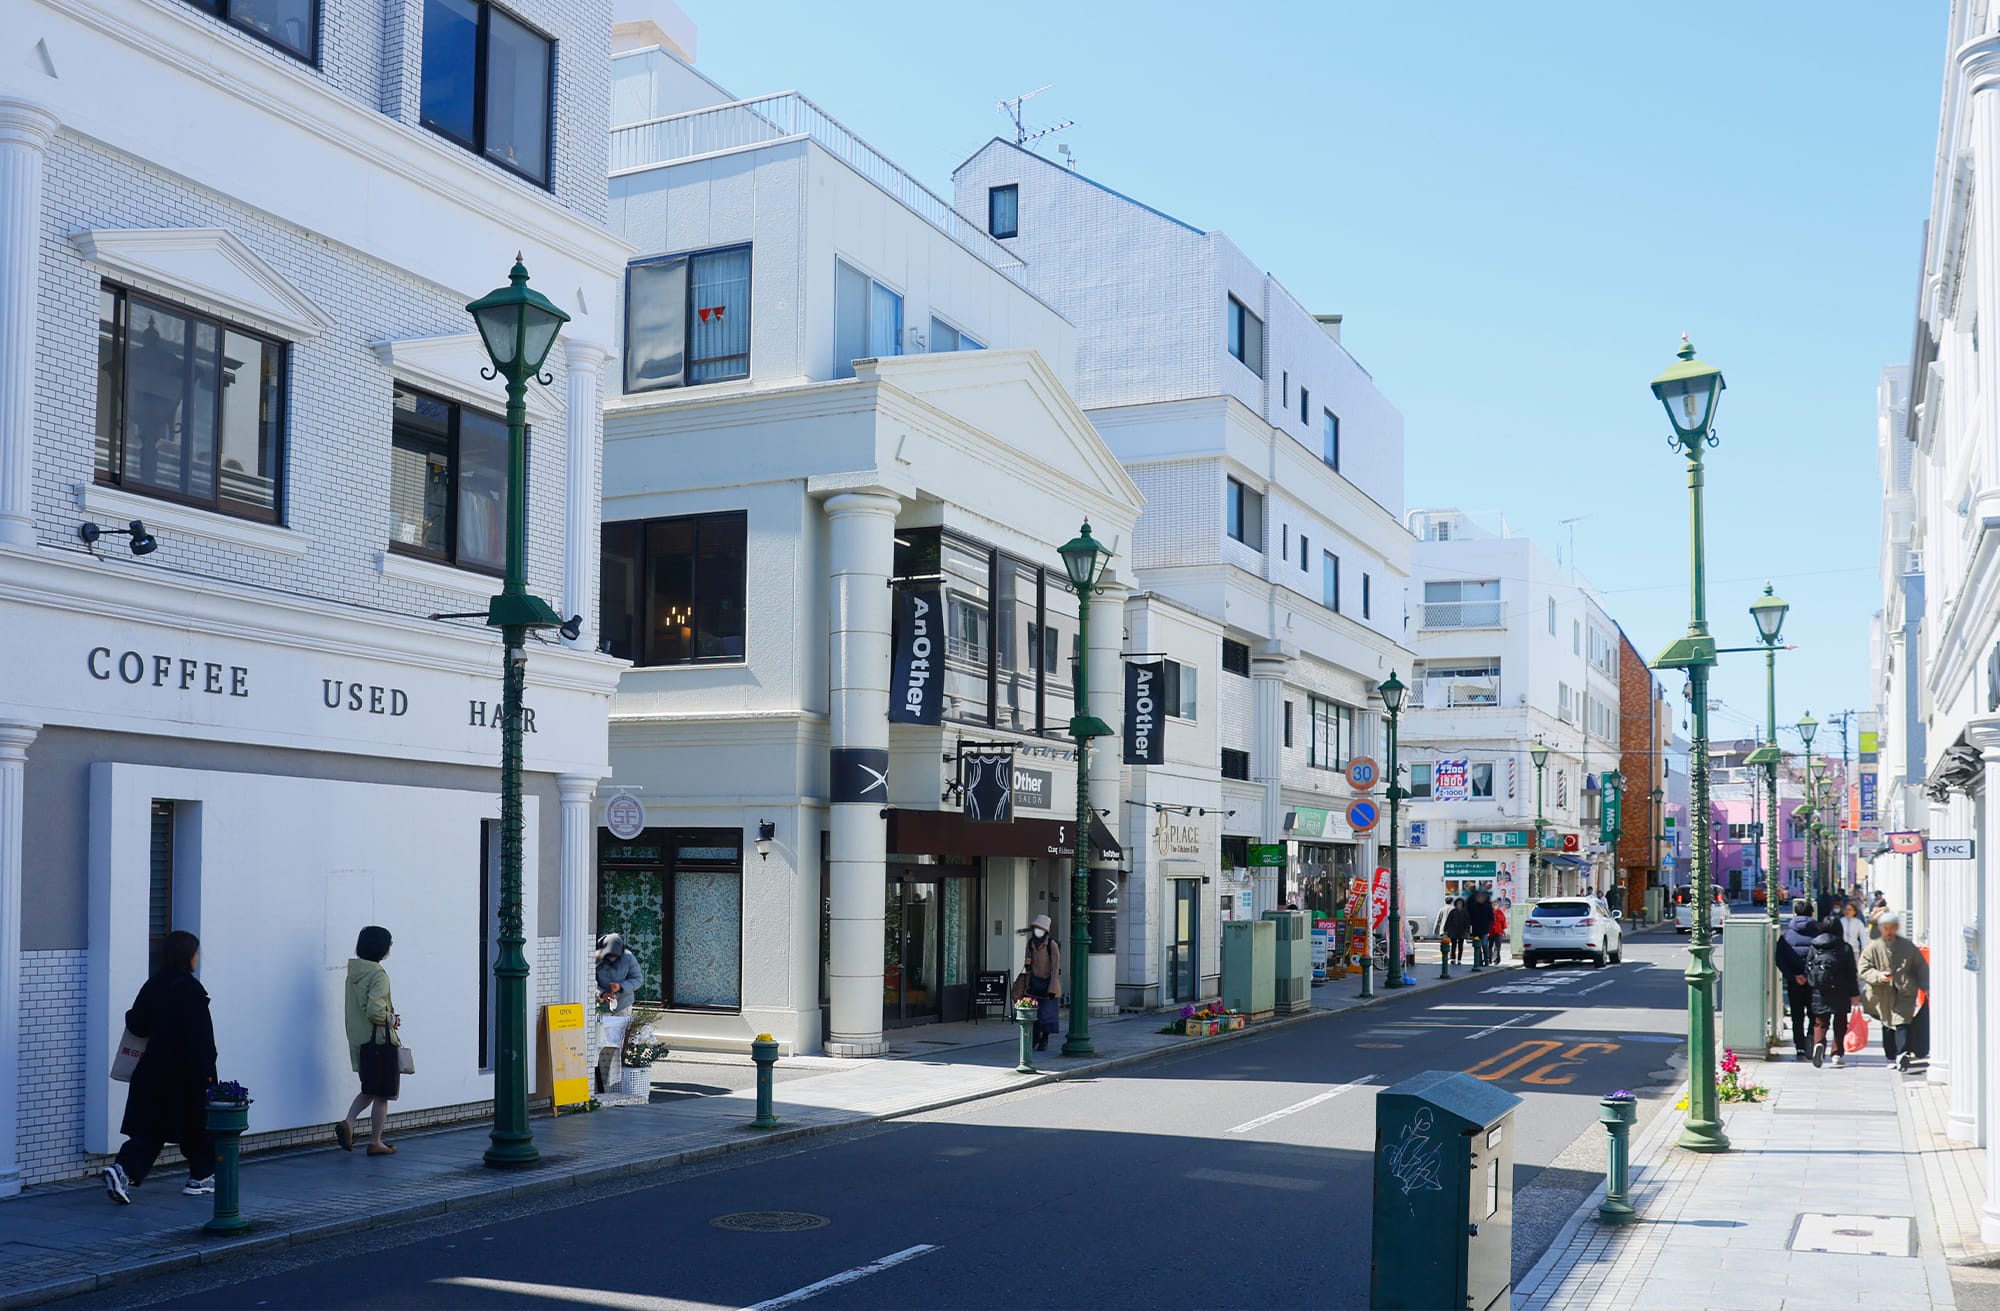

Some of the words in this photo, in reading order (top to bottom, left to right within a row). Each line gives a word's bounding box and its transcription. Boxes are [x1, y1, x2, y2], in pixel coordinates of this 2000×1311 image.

[88, 646, 249, 698] COFFEE
[905, 597, 931, 717] AnOther
[322, 679, 409, 717] USED
[1135, 667, 1154, 759] AnOther
[469, 700, 538, 733] HAR
[1353, 765, 1373, 781] 30
[1018, 795, 1042, 805] SALON
[1059, 826, 1065, 844] 5
[1170, 825, 1200, 844] PLACE
